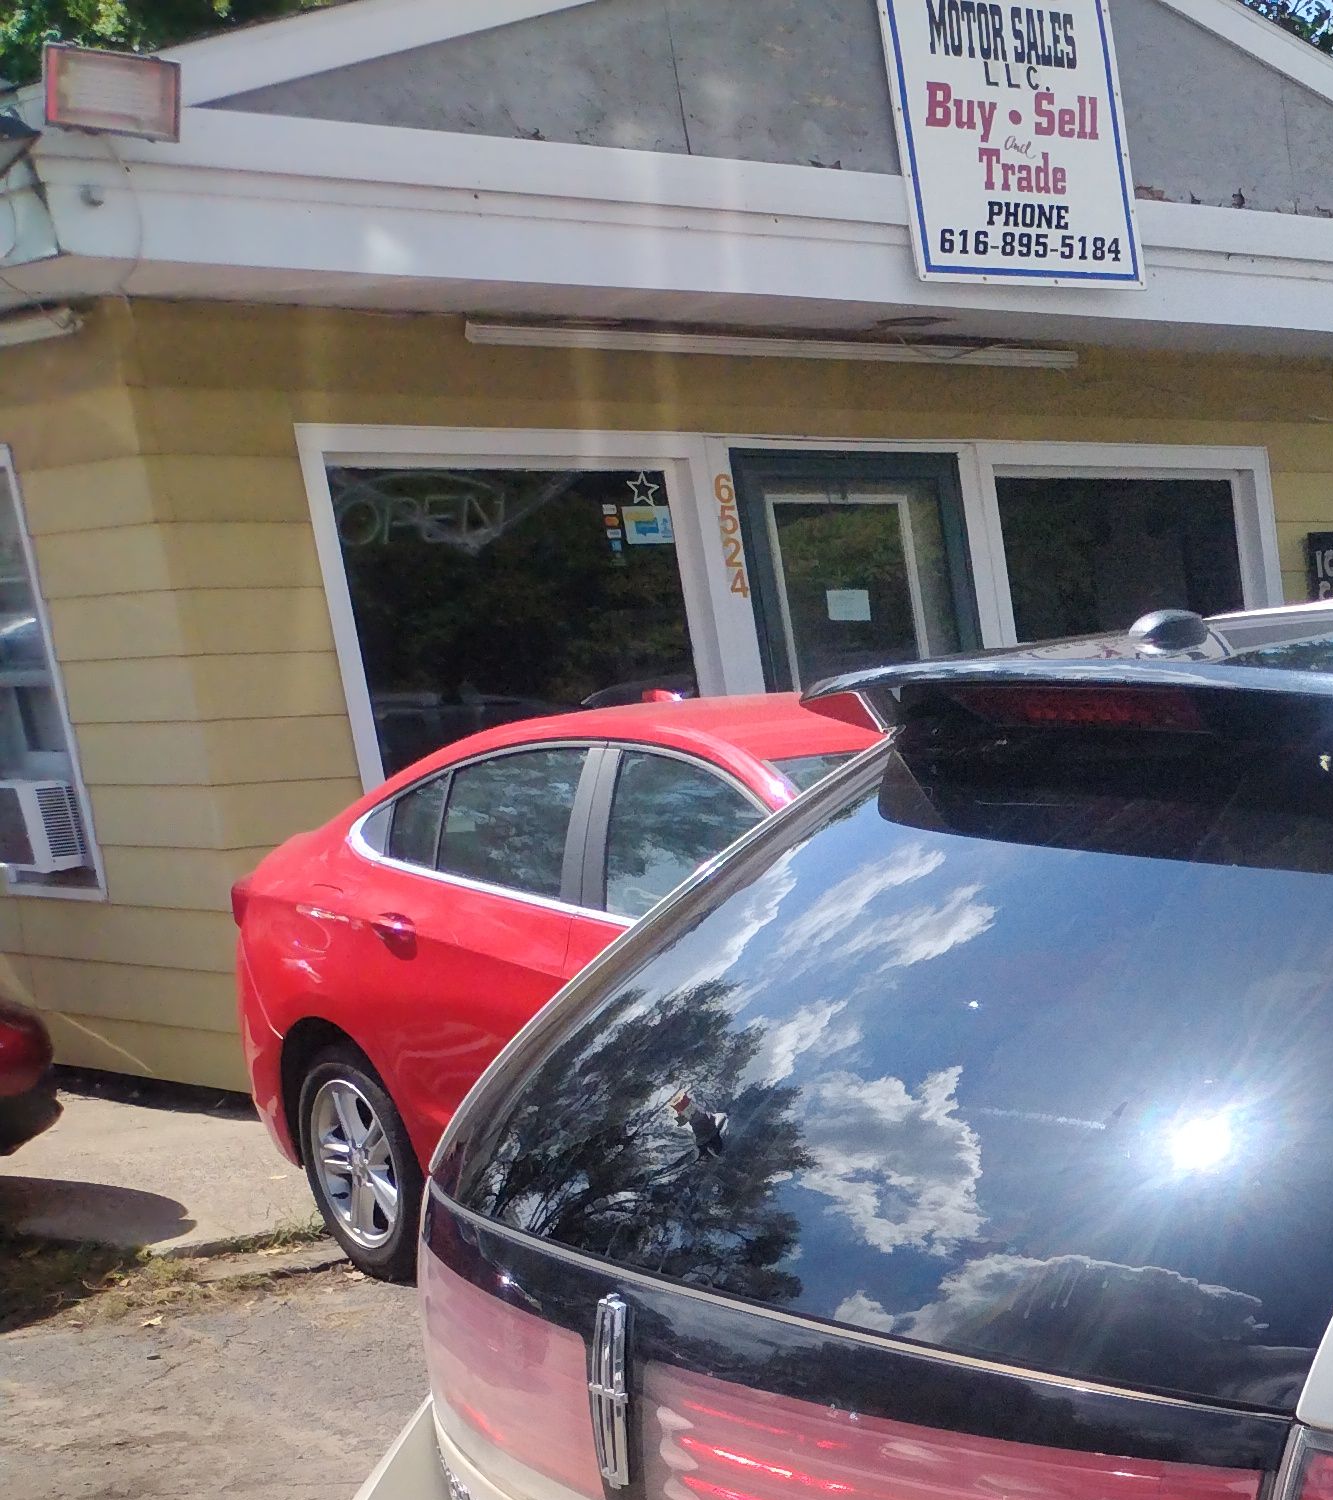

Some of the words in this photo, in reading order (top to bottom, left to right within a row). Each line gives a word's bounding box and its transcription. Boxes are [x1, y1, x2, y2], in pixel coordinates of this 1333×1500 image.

[927, 0, 1008, 62] MOTOR
[1011, 7, 1077, 70] SALES
[926, 81, 998, 143] Buy
[1034, 90, 1099, 141] Sell
[978, 147, 1067, 195] Trade
[986, 200, 1070, 231] PHONE
[939, 228, 1121, 263] 616-895-5184
[339, 492, 506, 546] OPEN
